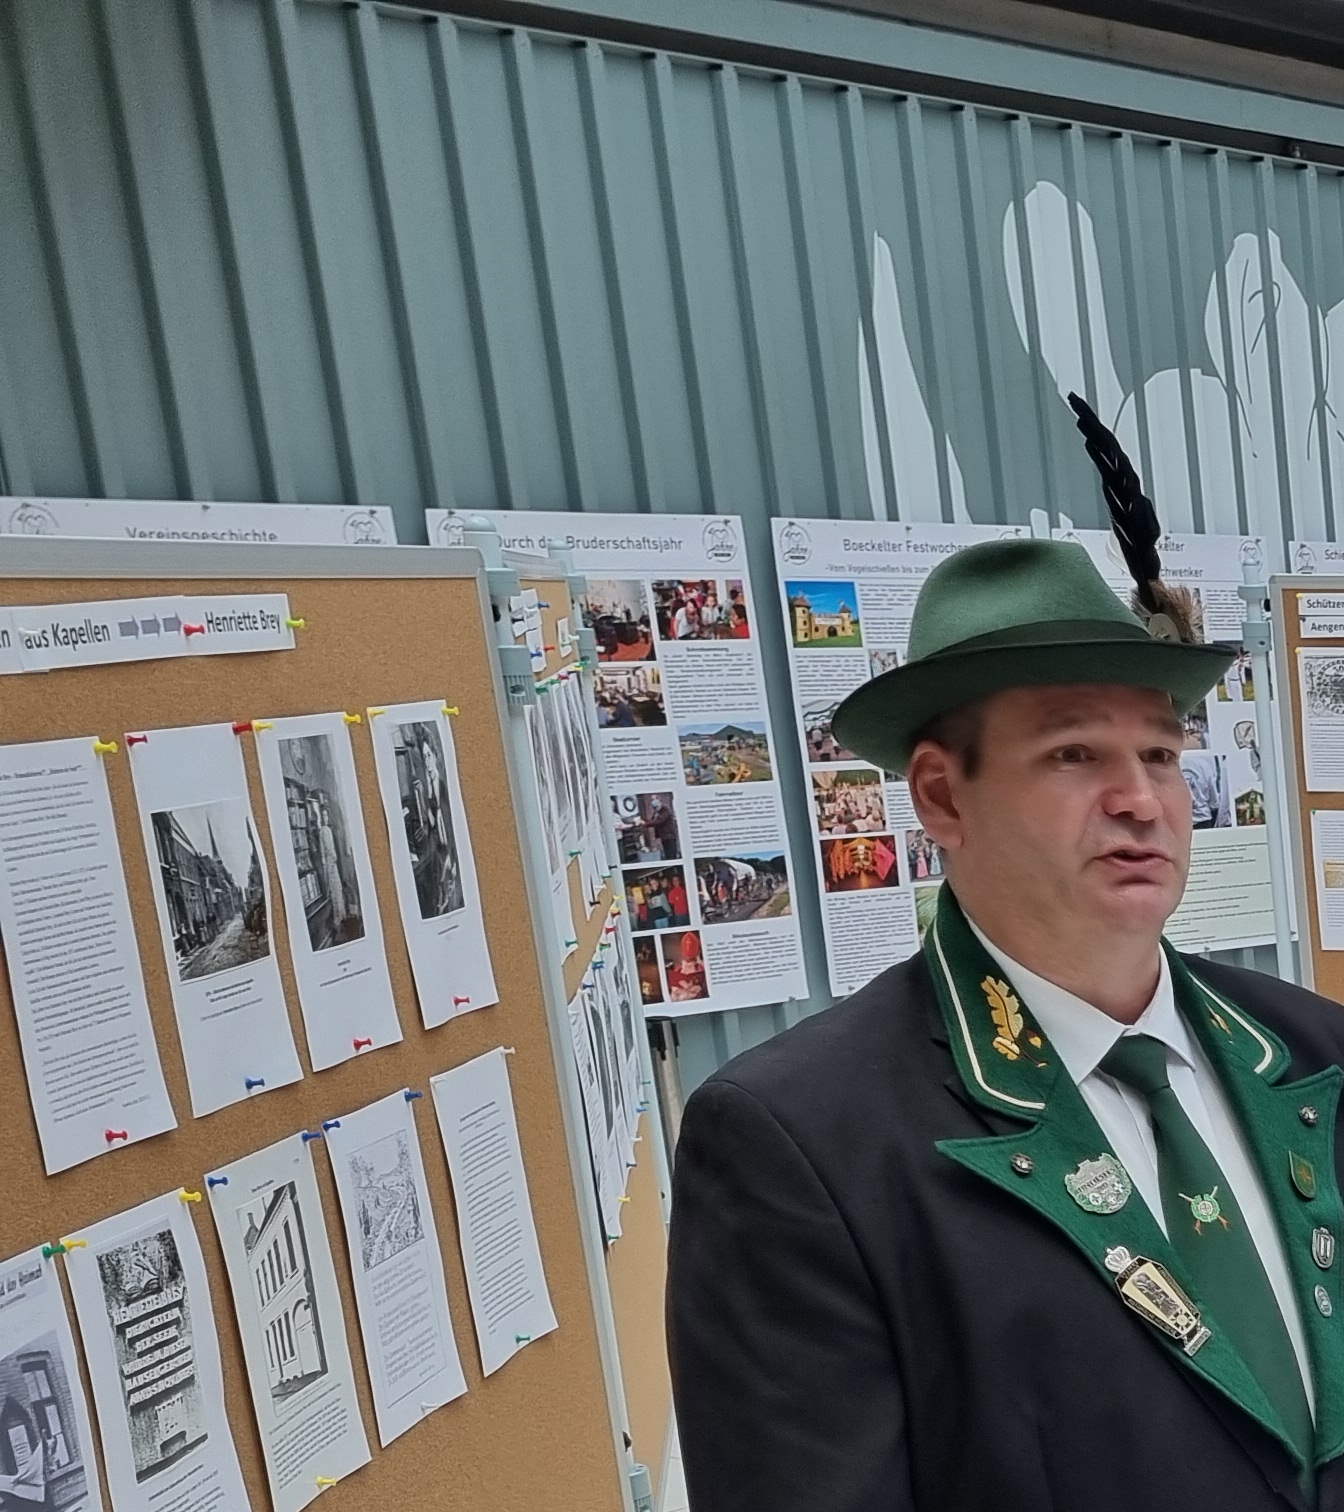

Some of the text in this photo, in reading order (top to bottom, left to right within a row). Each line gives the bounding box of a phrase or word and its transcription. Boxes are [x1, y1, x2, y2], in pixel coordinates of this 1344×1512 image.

[565, 535, 683, 553] Bruderschaftsjahr
[842, 539, 903, 552] Boeckelter
[51, 621, 111, 652] Kapellen
[205, 610, 259, 633] Henriette
[260, 610, 281, 634] Brey
